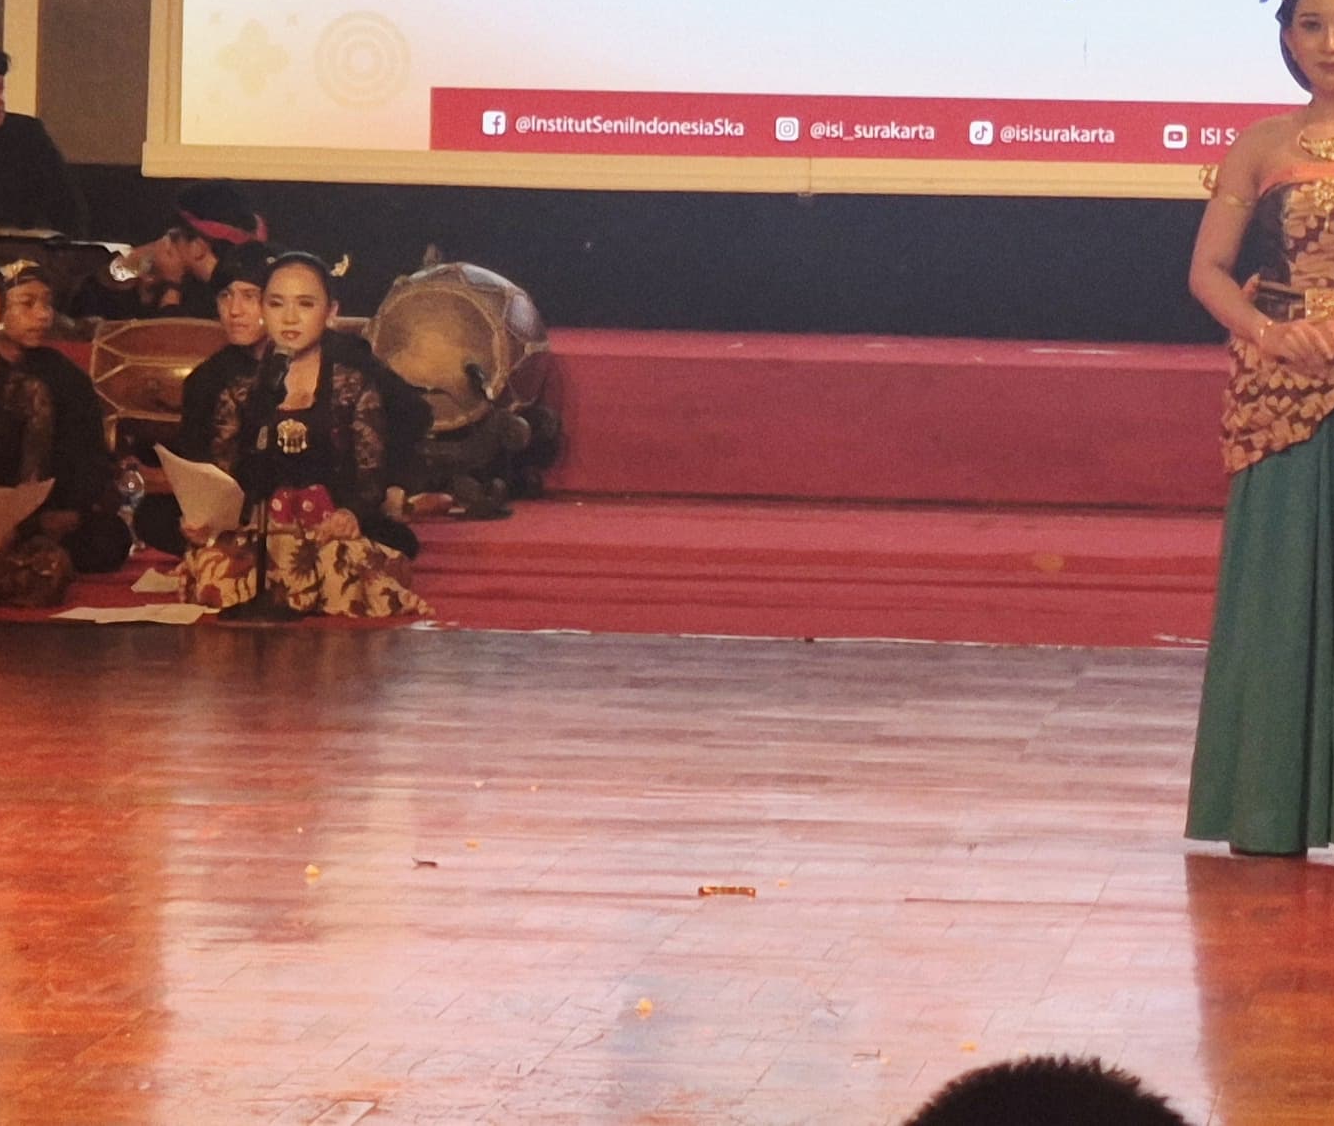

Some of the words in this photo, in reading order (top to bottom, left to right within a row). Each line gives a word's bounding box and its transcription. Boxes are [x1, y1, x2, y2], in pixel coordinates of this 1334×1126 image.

[515, 114, 745, 138] @InstitutSeniIndonesiaSka
[810, 120, 936, 143] @isi_surakarta
[1000, 124, 1115, 147] @isisurakarta
[1200, 127, 1221, 146] ISI
